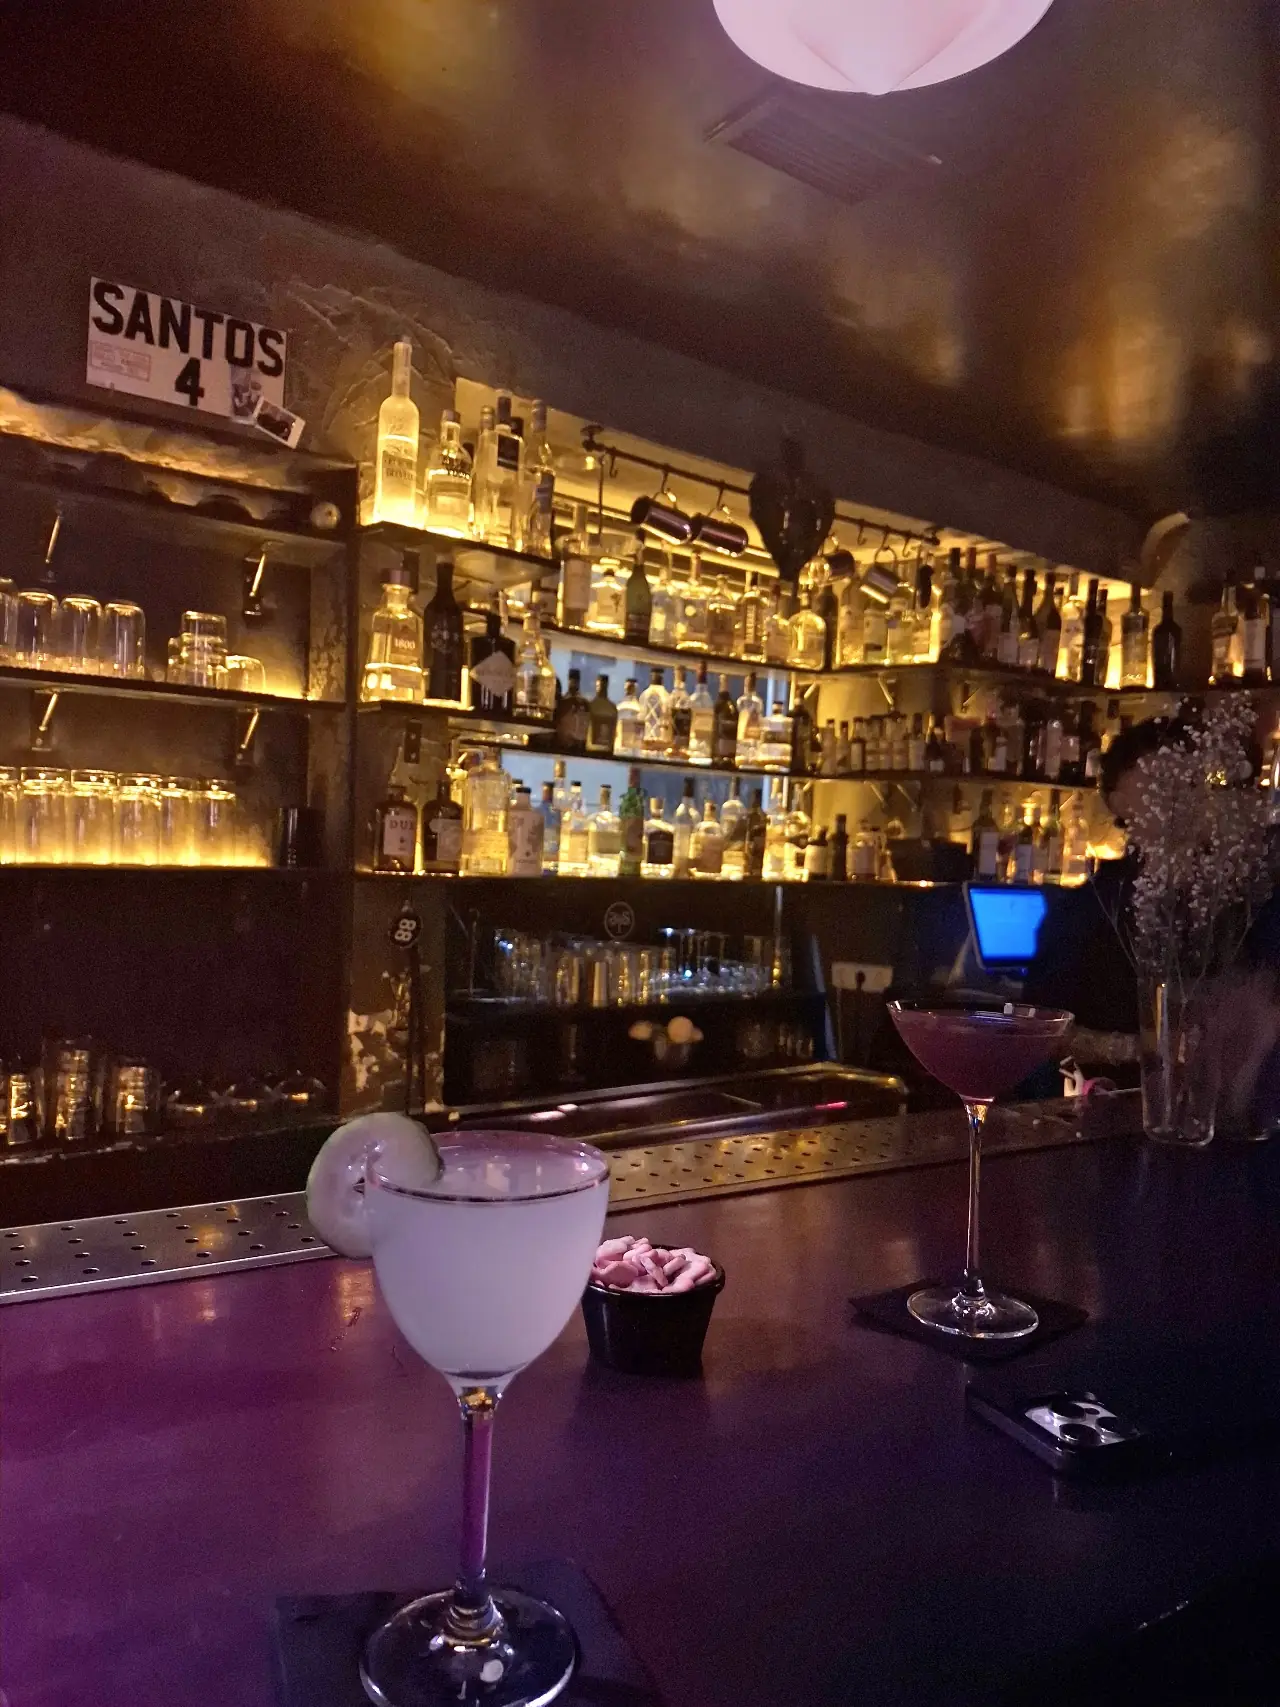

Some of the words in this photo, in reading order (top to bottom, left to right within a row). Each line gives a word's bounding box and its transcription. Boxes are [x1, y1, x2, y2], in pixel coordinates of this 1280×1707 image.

[92, 281, 284, 378] SANTOS
[174, 357, 205, 406] 4
[394, 638, 416, 649] 1800
